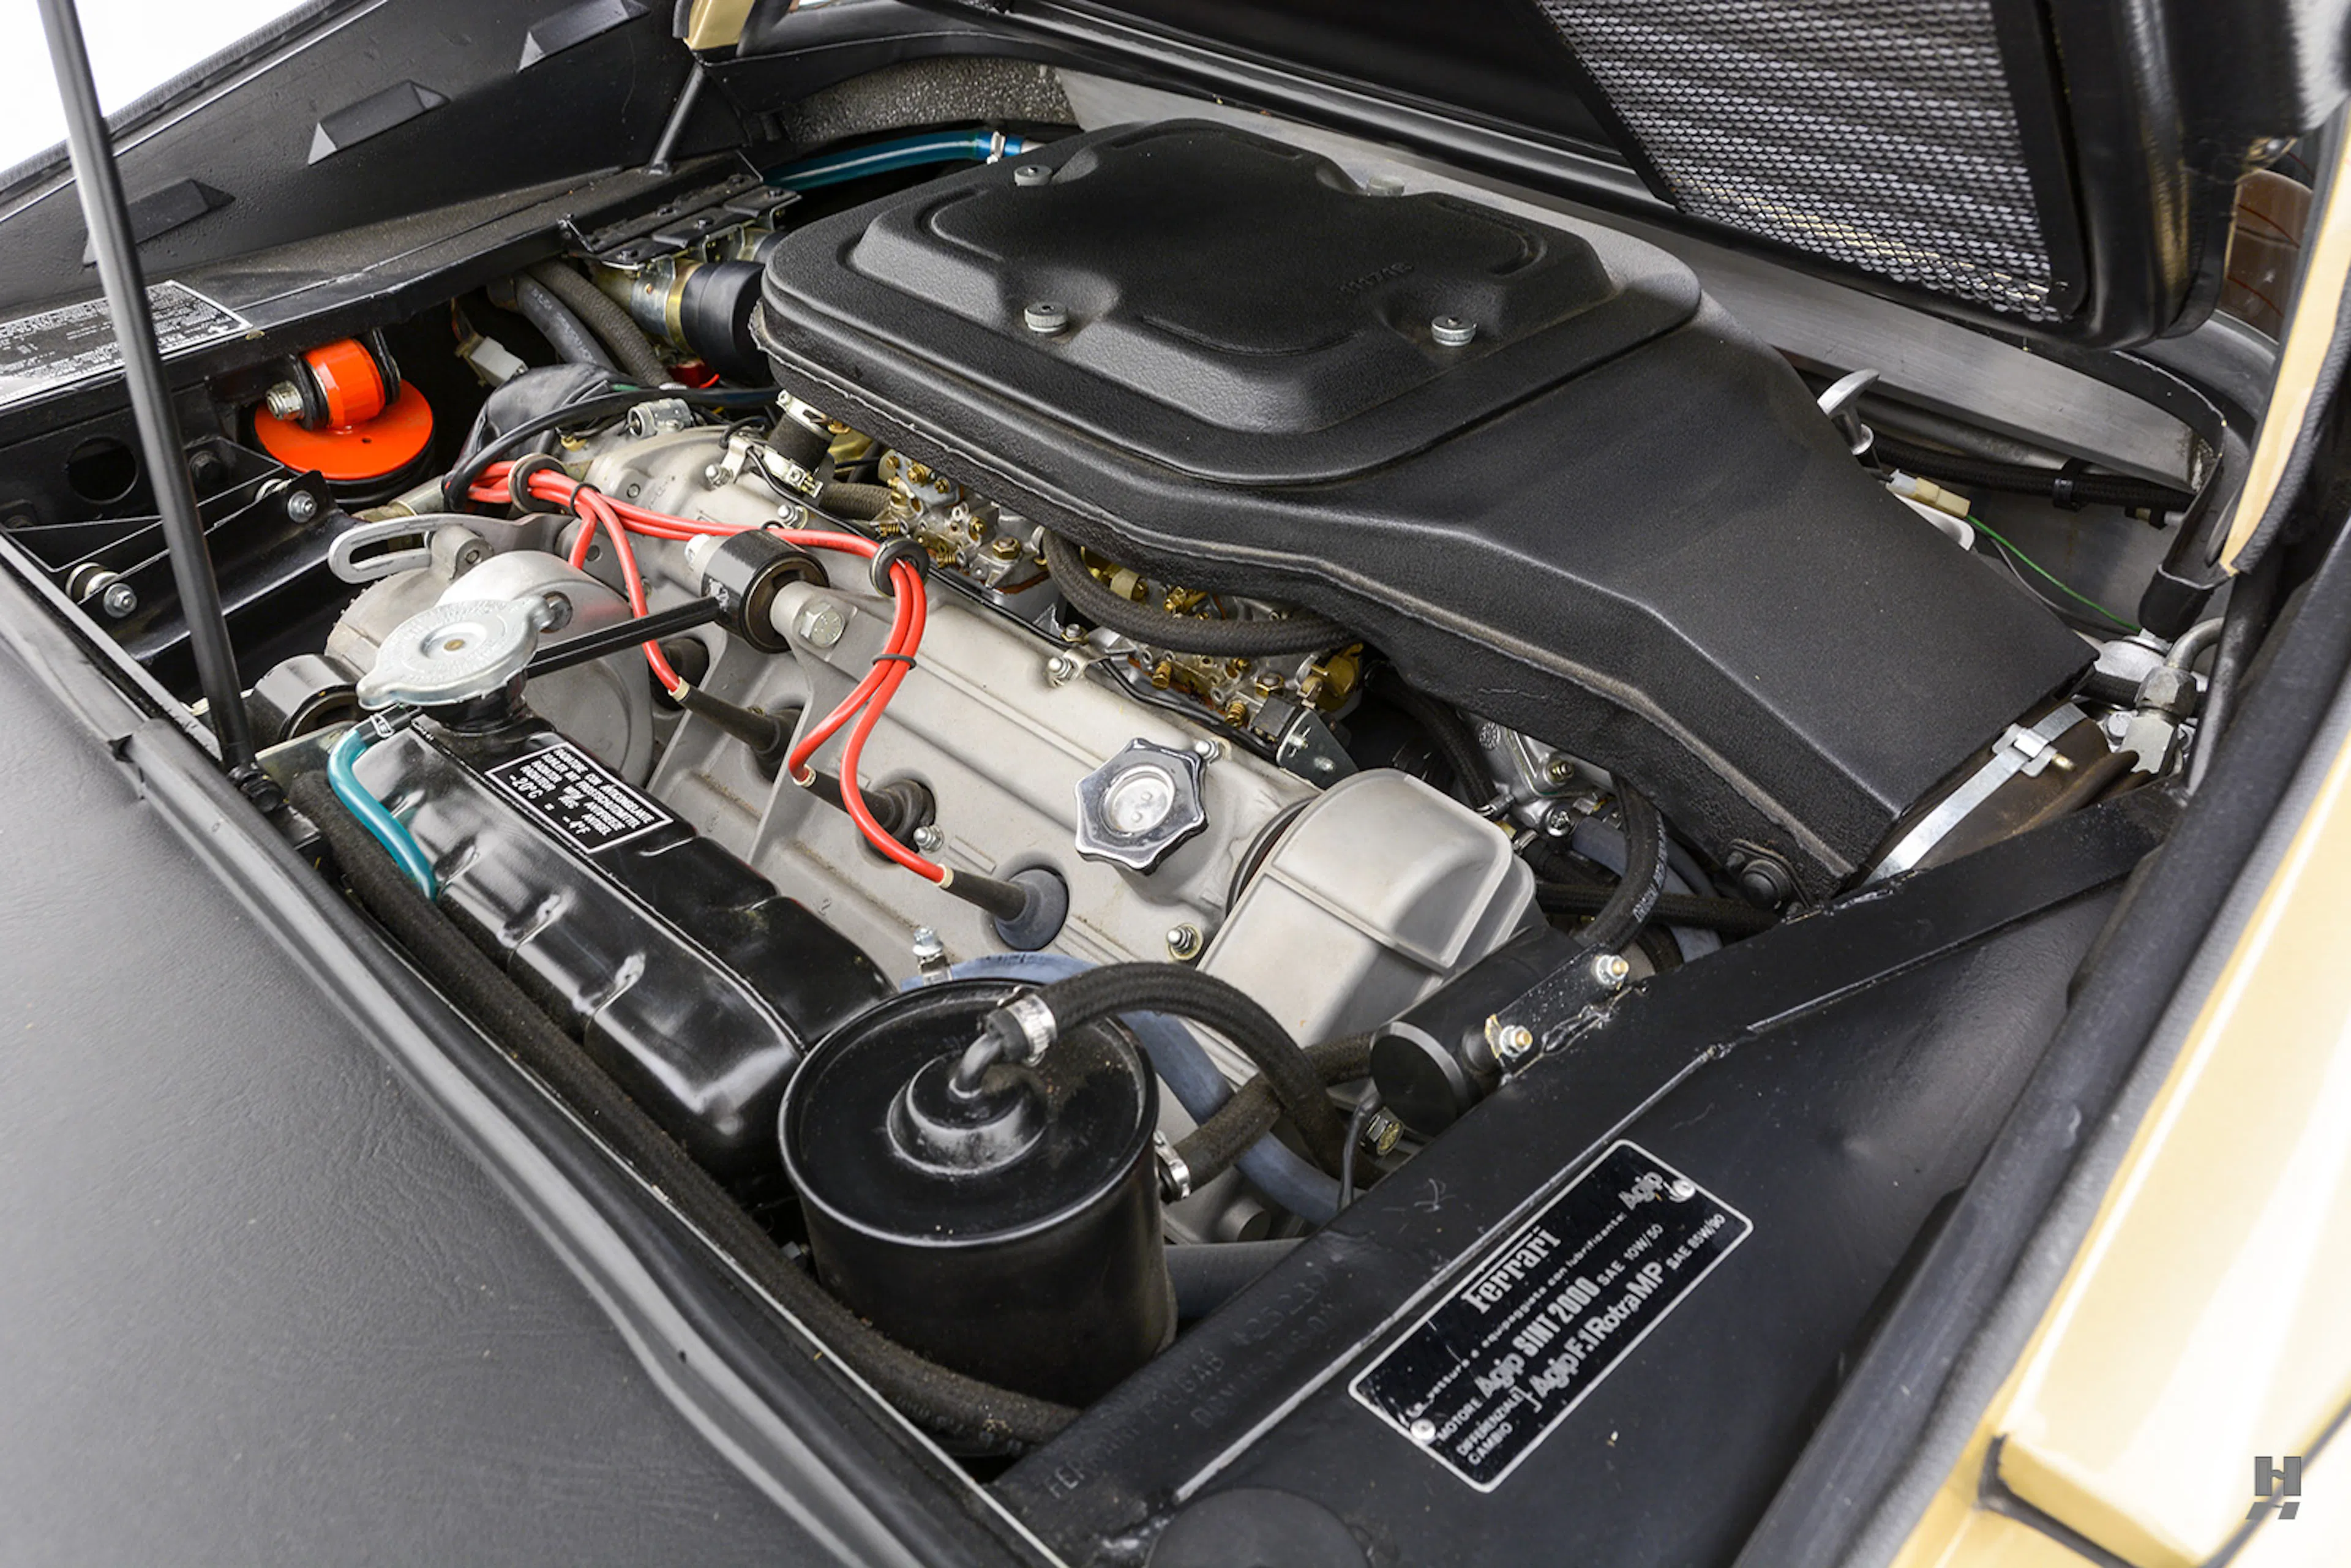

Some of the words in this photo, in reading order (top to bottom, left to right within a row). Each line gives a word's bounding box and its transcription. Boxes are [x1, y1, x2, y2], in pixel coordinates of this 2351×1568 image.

[1432, 1398, 1483, 1442] MOTORE
[1474, 1352, 1525, 1399] Agip
[1512, 1313, 1561, 1357] SINT
[1547, 1276, 1601, 1324] 2000
[1596, 1260, 1625, 1286] SAE
[1624, 1223, 1663, 1261] 10W/50
[1460, 1225, 1561, 1314] Ferrari
[1481, 1286, 1547, 1348] equipaggiata
[1547, 1267, 1567, 1286] con
[1618, 1171, 1663, 1210] Agip
[1456, 1390, 1524, 1457] DIFFERENZIALE
[1665, 1245, 1692, 1270] SAE
[1468, 1422, 1513, 1465] CAMBIO
